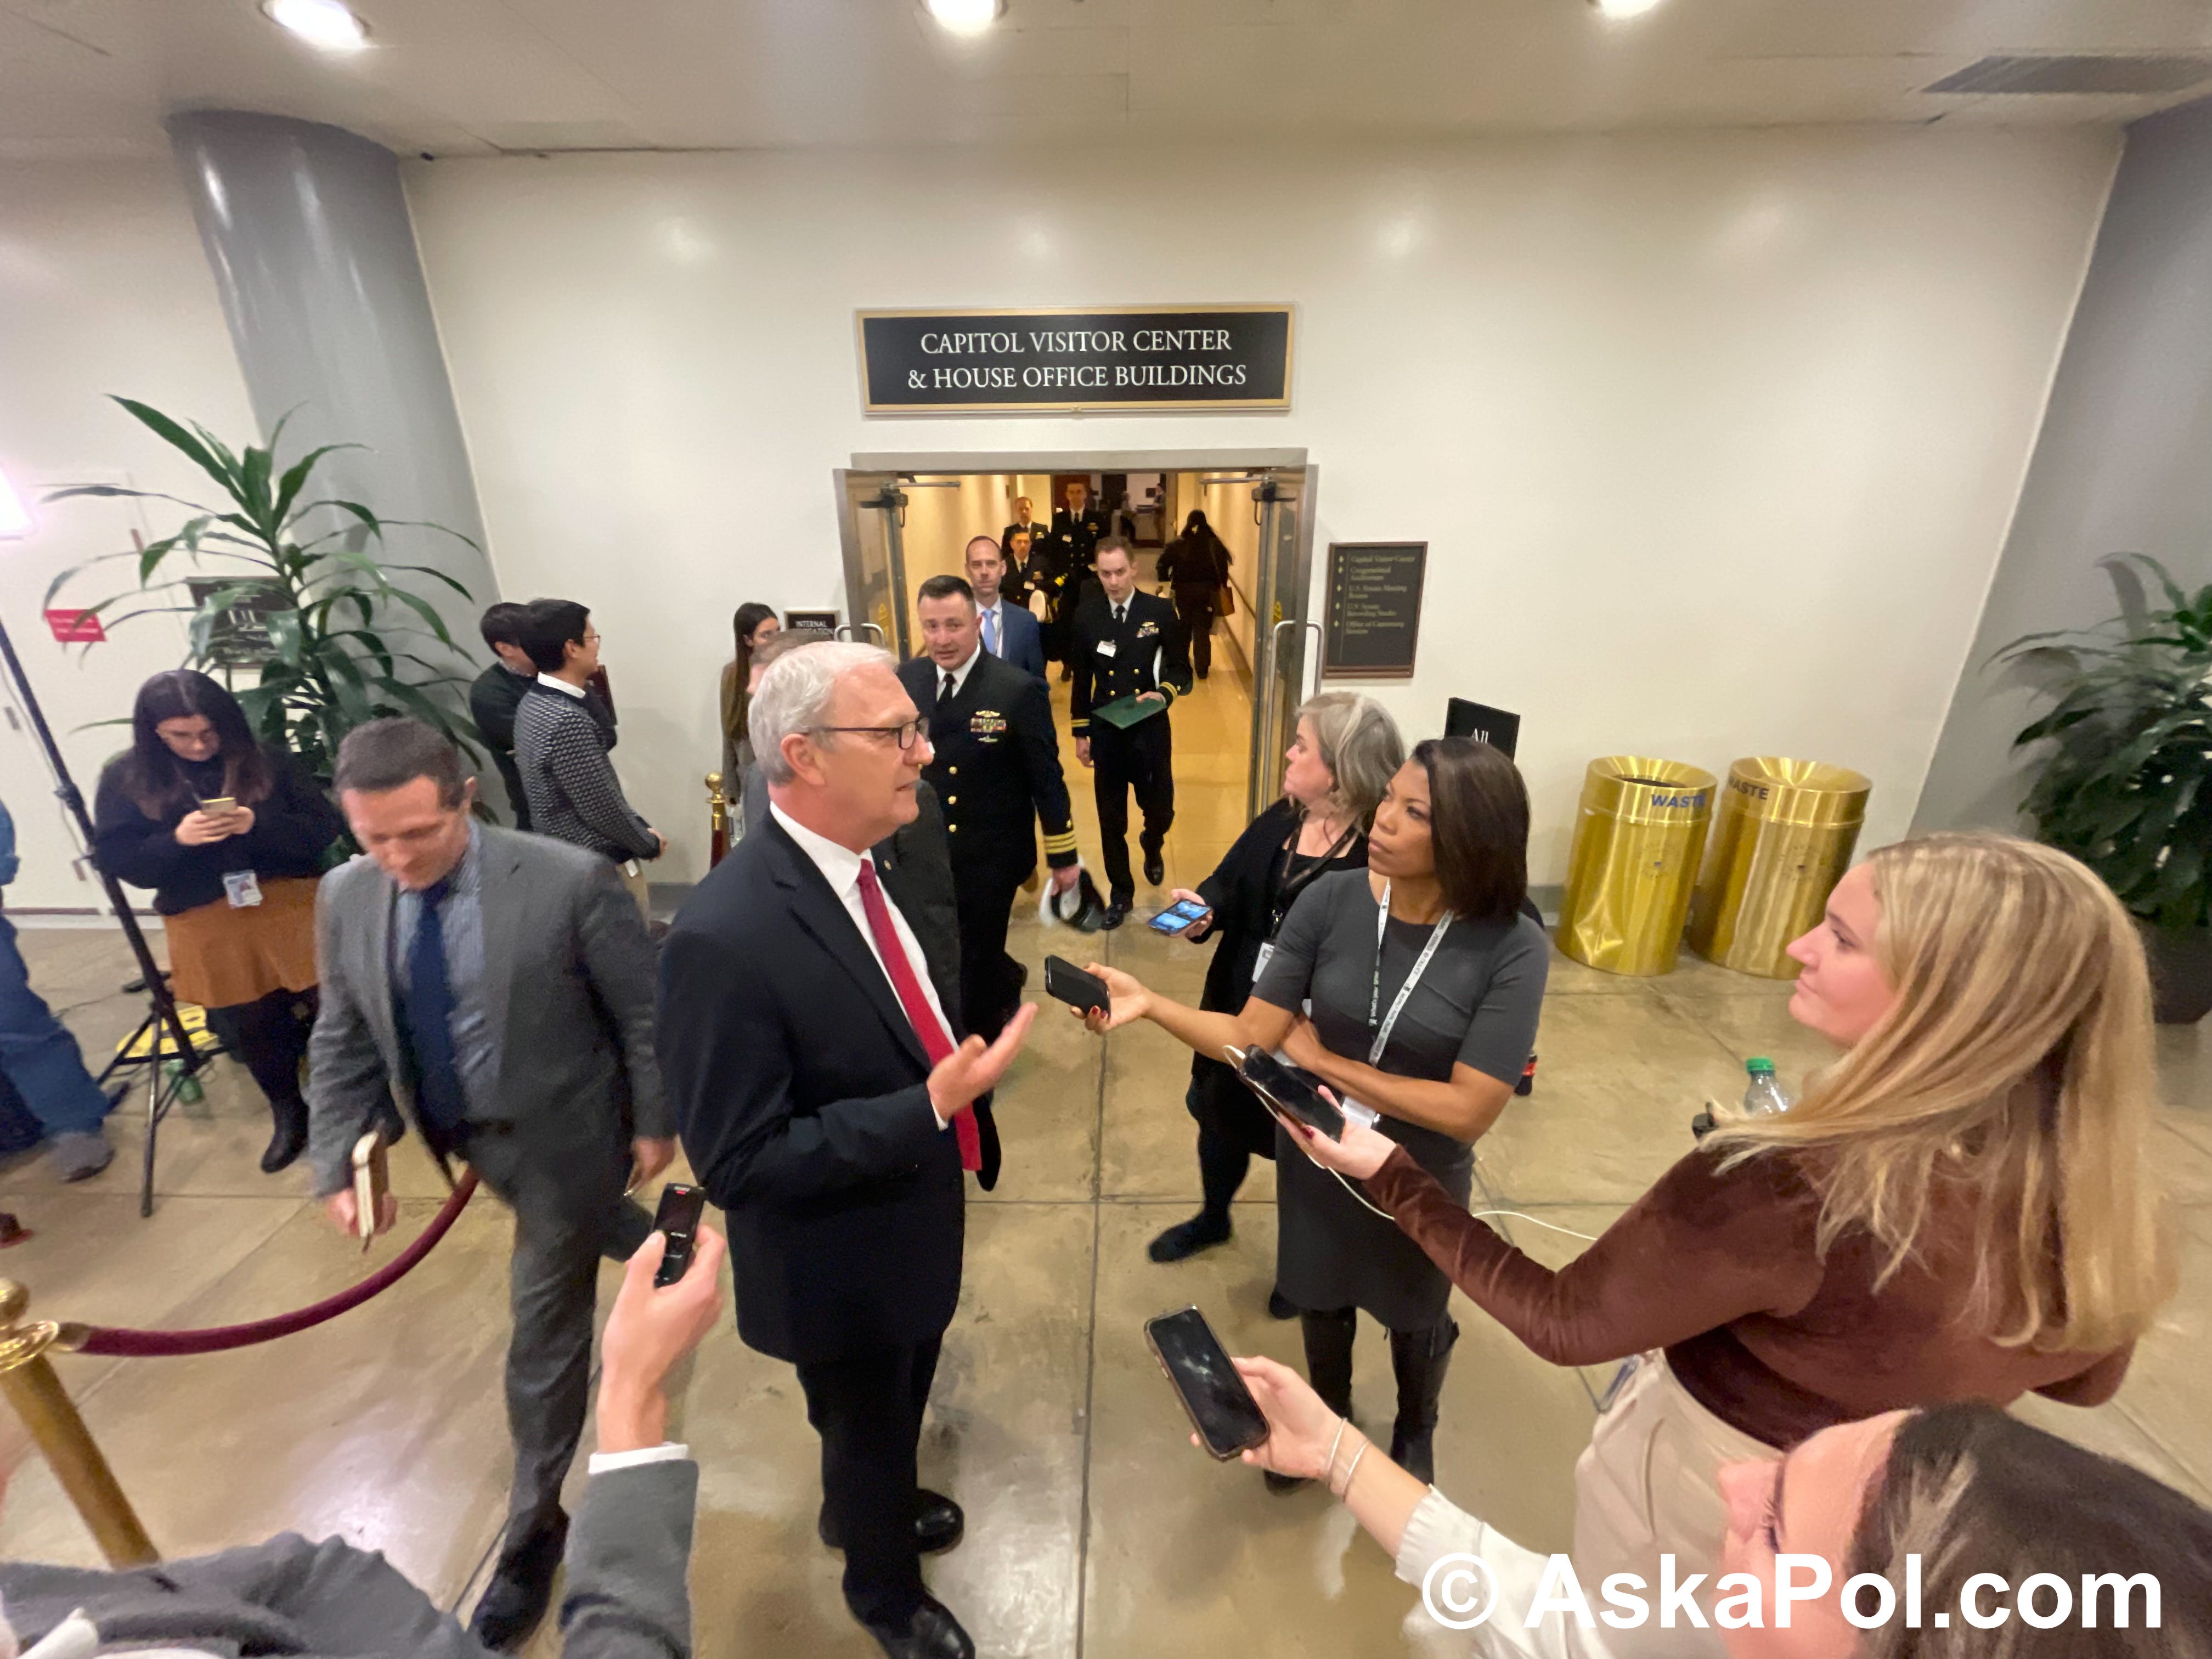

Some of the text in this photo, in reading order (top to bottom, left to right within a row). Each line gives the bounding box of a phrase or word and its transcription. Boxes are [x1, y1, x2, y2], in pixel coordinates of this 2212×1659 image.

[921, 329, 1232, 354] CAPITOL VISITOR CENTER
[908, 364, 1246, 389] & HOUSE OFFICE BUILDINGS
